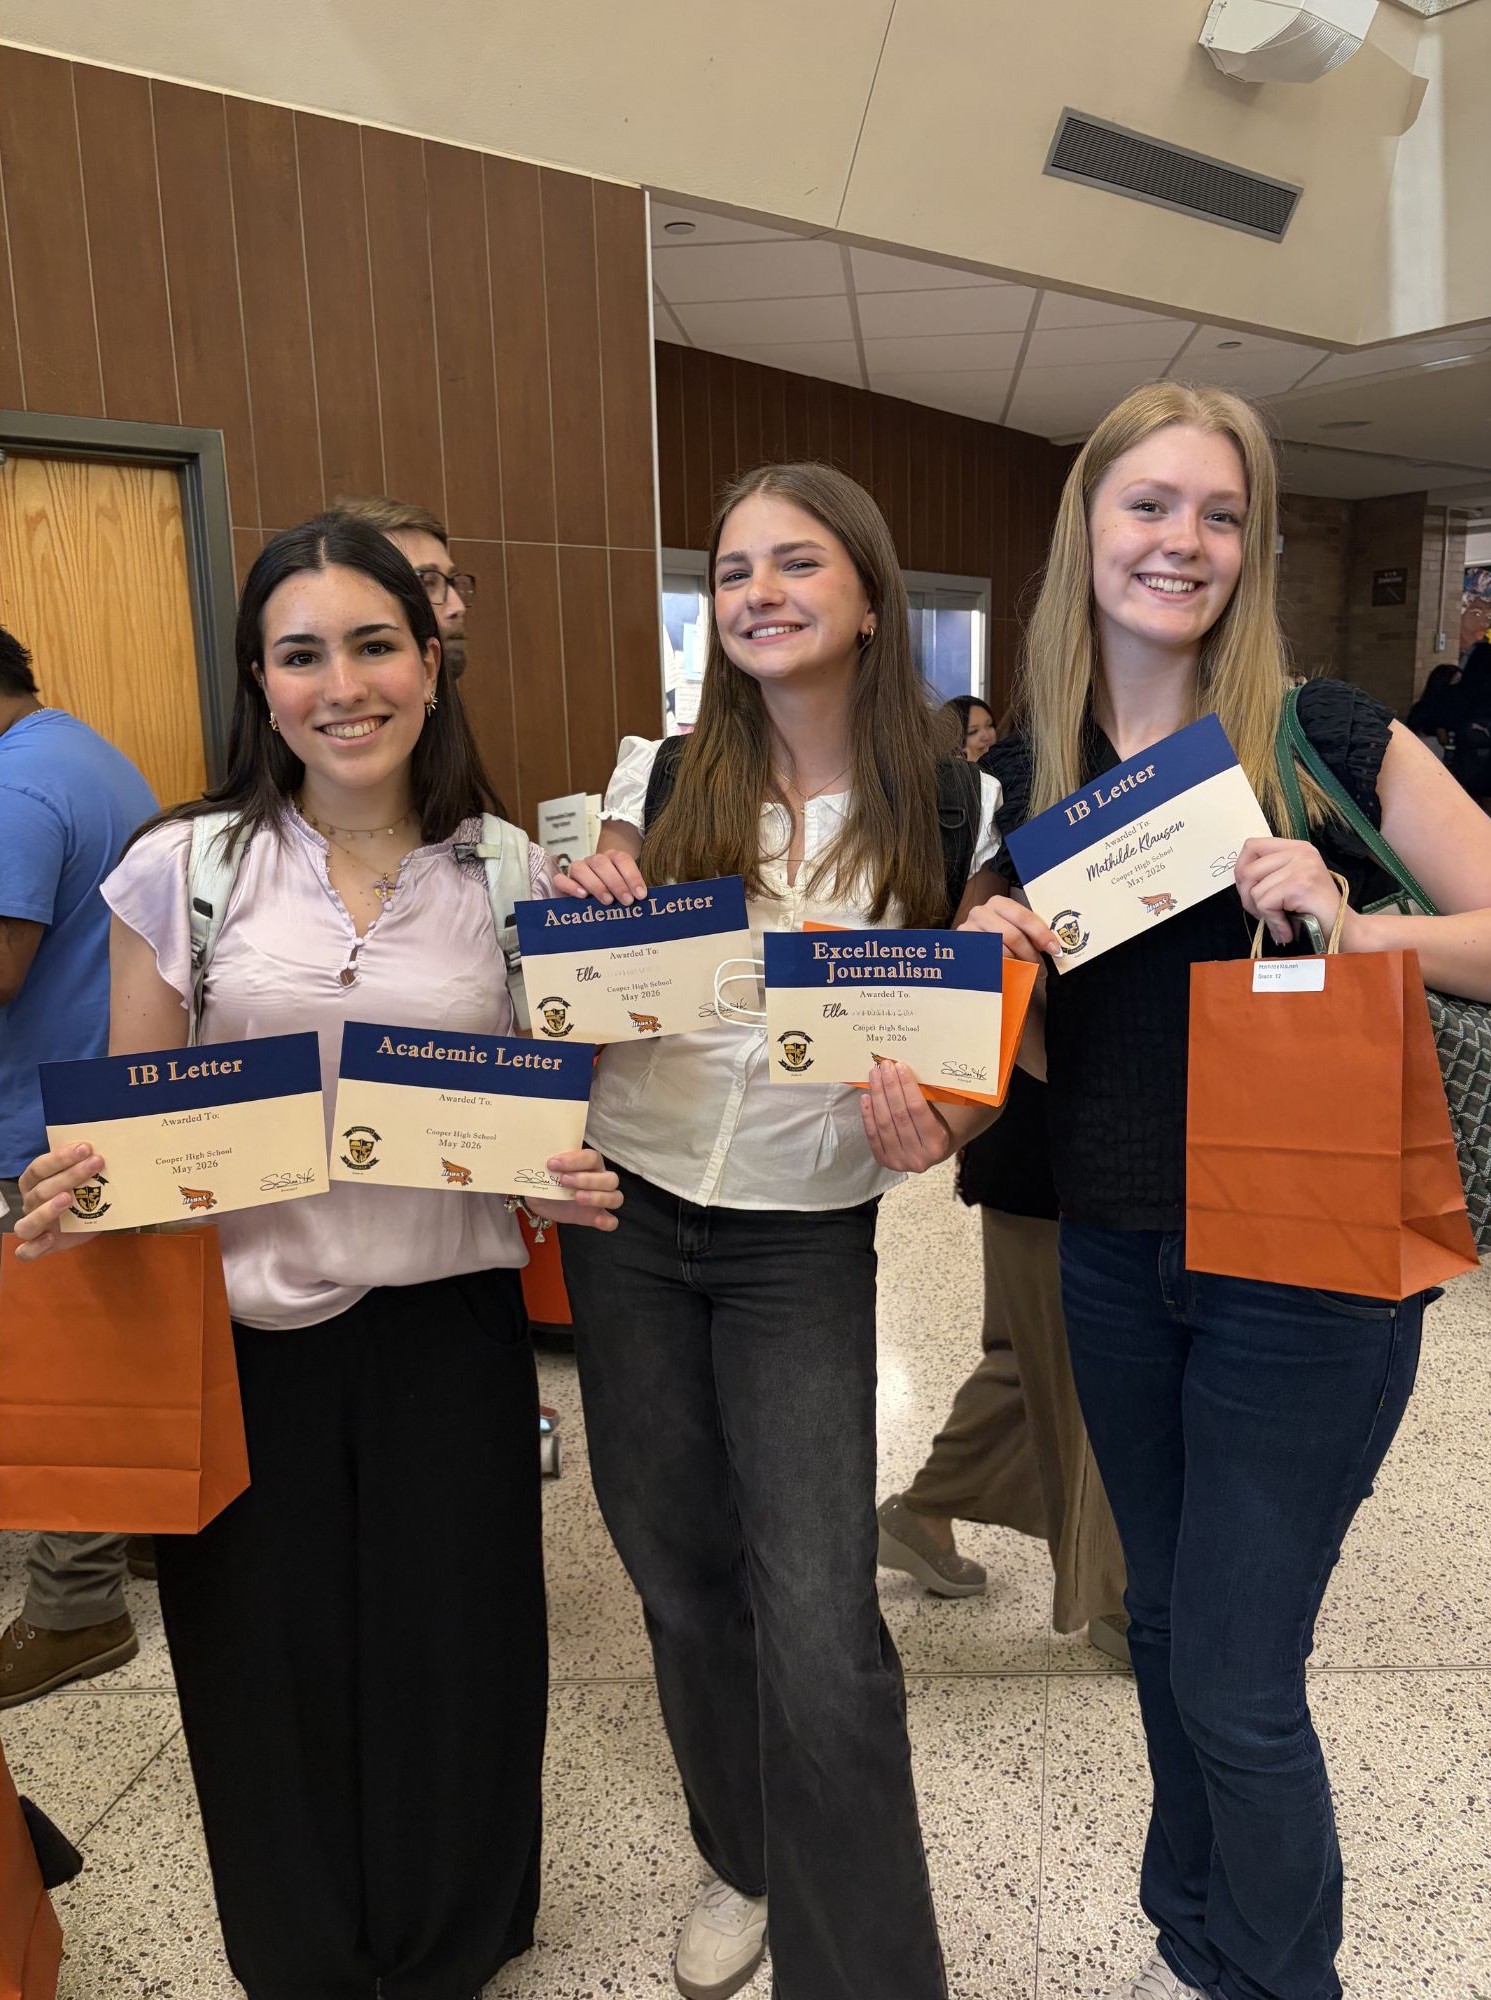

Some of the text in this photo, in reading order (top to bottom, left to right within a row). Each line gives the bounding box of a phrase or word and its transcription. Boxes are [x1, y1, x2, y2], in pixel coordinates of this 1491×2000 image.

[1064, 764, 1156, 826] IB Letter
[1105, 826, 1137, 850] Awarded
[1086, 821, 1185, 882] Mathilde Klausen
[1110, 846, 1174, 885] Cooper High School
[1126, 863, 1166, 888] May 2026
[544, 895, 714, 927] Academic Letter
[609, 949, 644, 960] Awarded
[812, 940, 956, 960] Excellence in
[576, 966, 601, 982] Ella
[826, 961, 943, 984] Journalism
[607, 979, 672, 994] Cooper High School
[859, 990, 895, 998] Awarded
[621, 989, 661, 1002] May 2026
[822, 1002, 849, 1018] Ella
[866, 1034, 907, 1043] May 2026
[376, 1036, 563, 1071] Academic Letter
[127, 1059, 242, 1086] IB Letter
[438, 1093, 477, 1105] Awarded
[161, 1112, 220, 1127] Awarded To:
[426, 1128, 451, 1137] Cooper
[453, 1131, 471, 1139] High
[438, 1139, 482, 1150] May 2026
[155, 1147, 232, 1165] Cooper High School
[172, 1160, 219, 1175] May 2026
